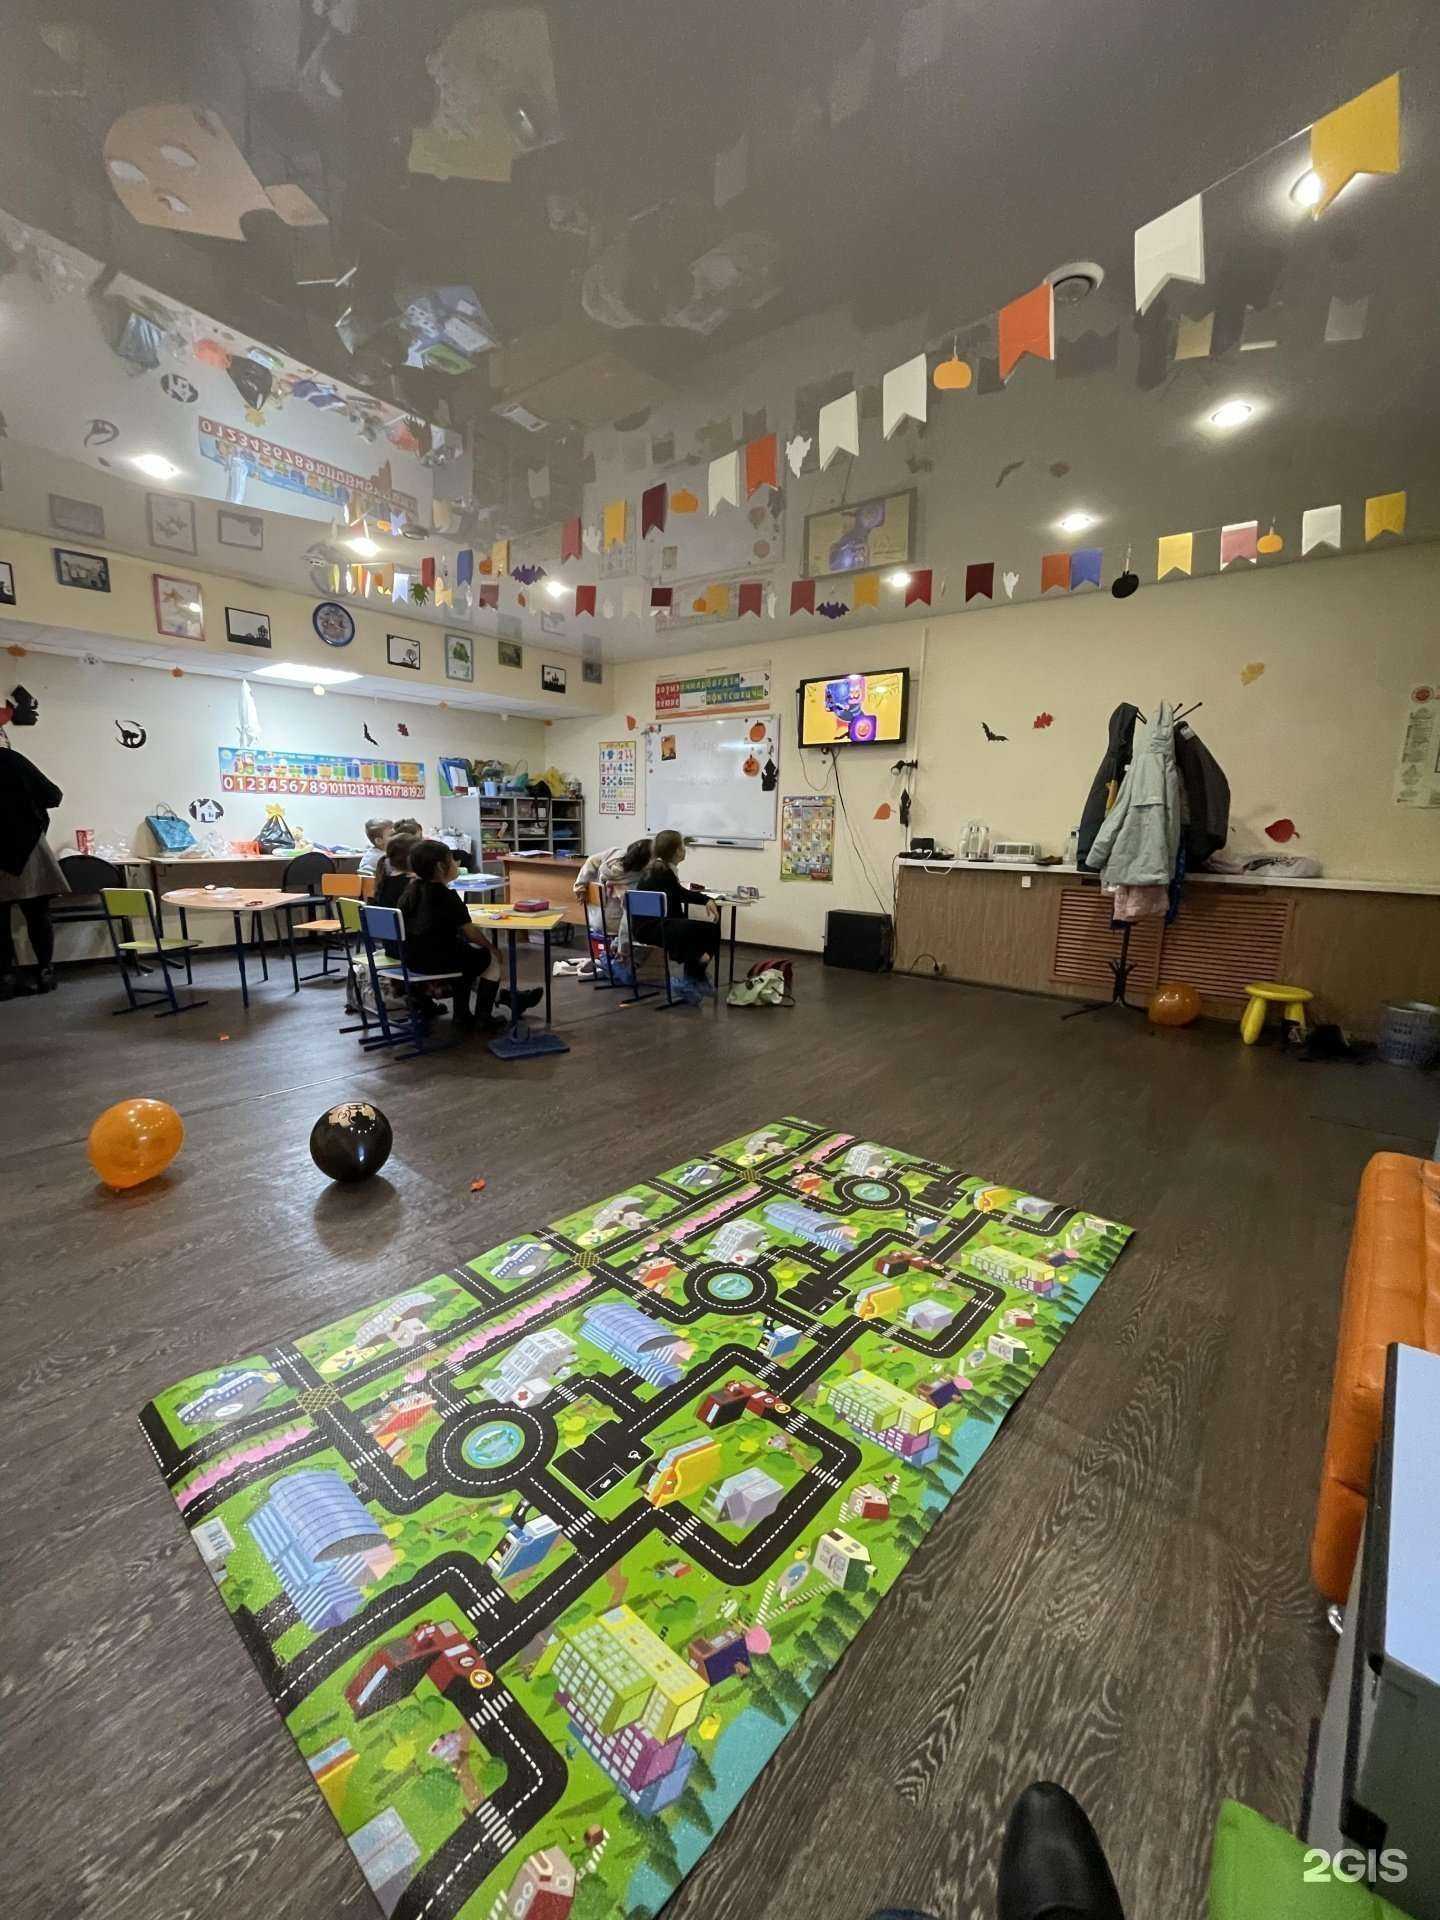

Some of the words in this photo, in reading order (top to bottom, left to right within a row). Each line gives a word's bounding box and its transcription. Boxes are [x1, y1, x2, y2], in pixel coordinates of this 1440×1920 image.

[224, 777, 233, 789] 0
[237, 778, 243, 789] 1
[247, 778, 256, 790] 2
[259, 779, 266, 791] 3
[269, 779, 277, 791] 4
[280, 780, 288, 792] 5
[289, 780, 298, 792] 6
[300, 781, 308, 793] 7
[310, 781, 317, 794] 8
[320, 782, 327, 794] 9
[329, 782, 338, 794] 10
[340, 783, 347, 794] 11
[348, 784, 356, 794] 12
[357, 784, 365, 795] 13
[366, 784, 374, 795] 14
[375, 784, 383, 796] 15
[384, 785, 392, 796] 16
[392, 785, 400, 796] 17
[401, 786, 408, 797] 18
[409, 786, 416, 797] 19
[416, 786, 425, 798] 20
[618, 803, 624, 812] 10
